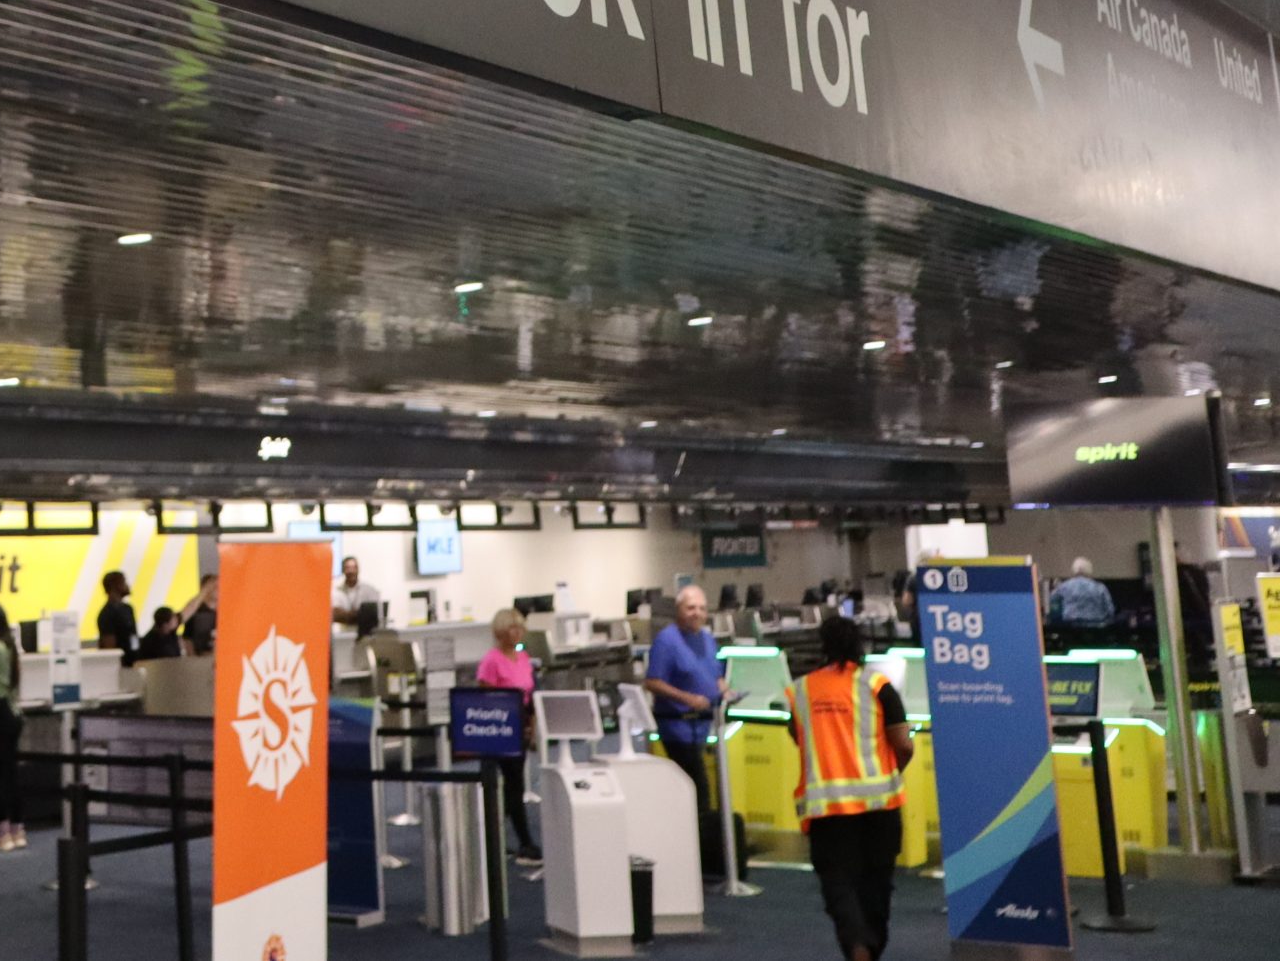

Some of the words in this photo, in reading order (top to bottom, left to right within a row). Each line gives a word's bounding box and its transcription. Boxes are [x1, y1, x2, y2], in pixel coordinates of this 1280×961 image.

[1214, 37, 1263, 106] United
[1075, 442, 1140, 464] spirit
[927, 604, 984, 638] Tag
[932, 636, 990, 670] Bag
[466, 707, 509, 723] Priority
[462, 723, 513, 737] Check-in
